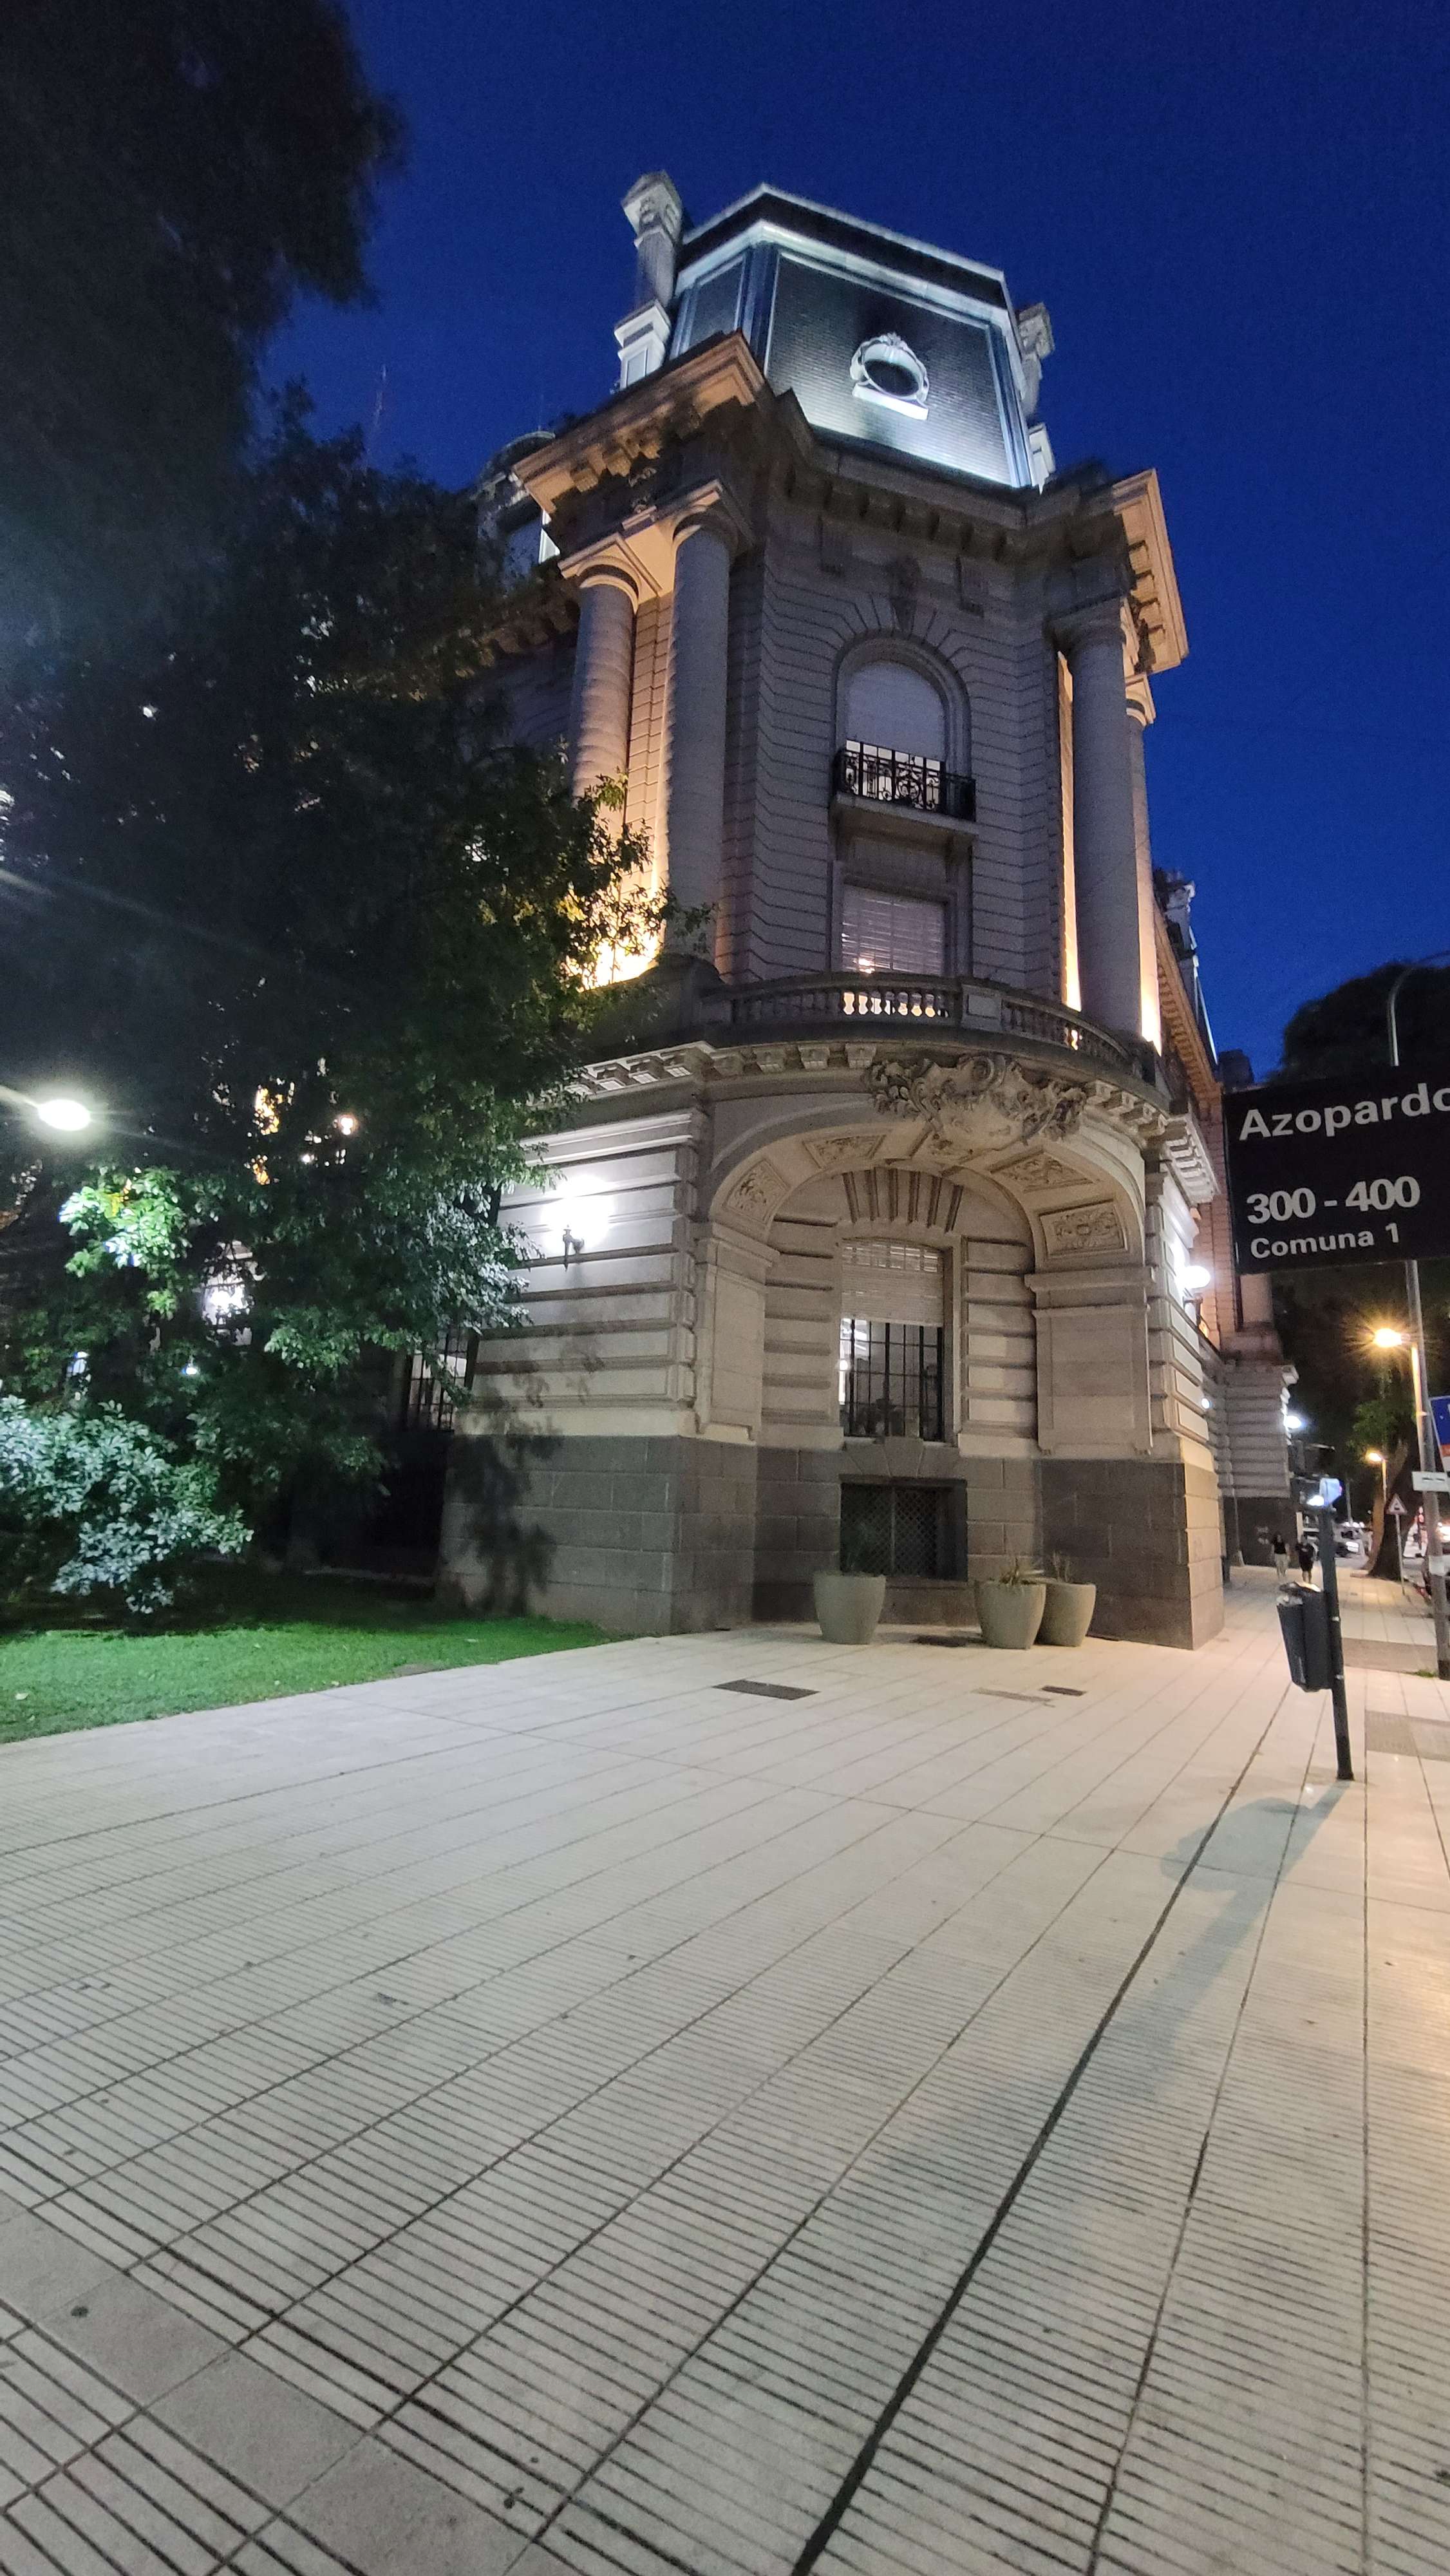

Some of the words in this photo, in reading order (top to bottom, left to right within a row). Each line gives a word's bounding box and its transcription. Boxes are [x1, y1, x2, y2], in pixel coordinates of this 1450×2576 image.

[1246, 1188, 1316, 1224] 300
[1345, 1176, 1420, 1211] 400
[1250, 1231, 1375, 1258] Comuna
[1385, 1222, 1399, 1243] 1
